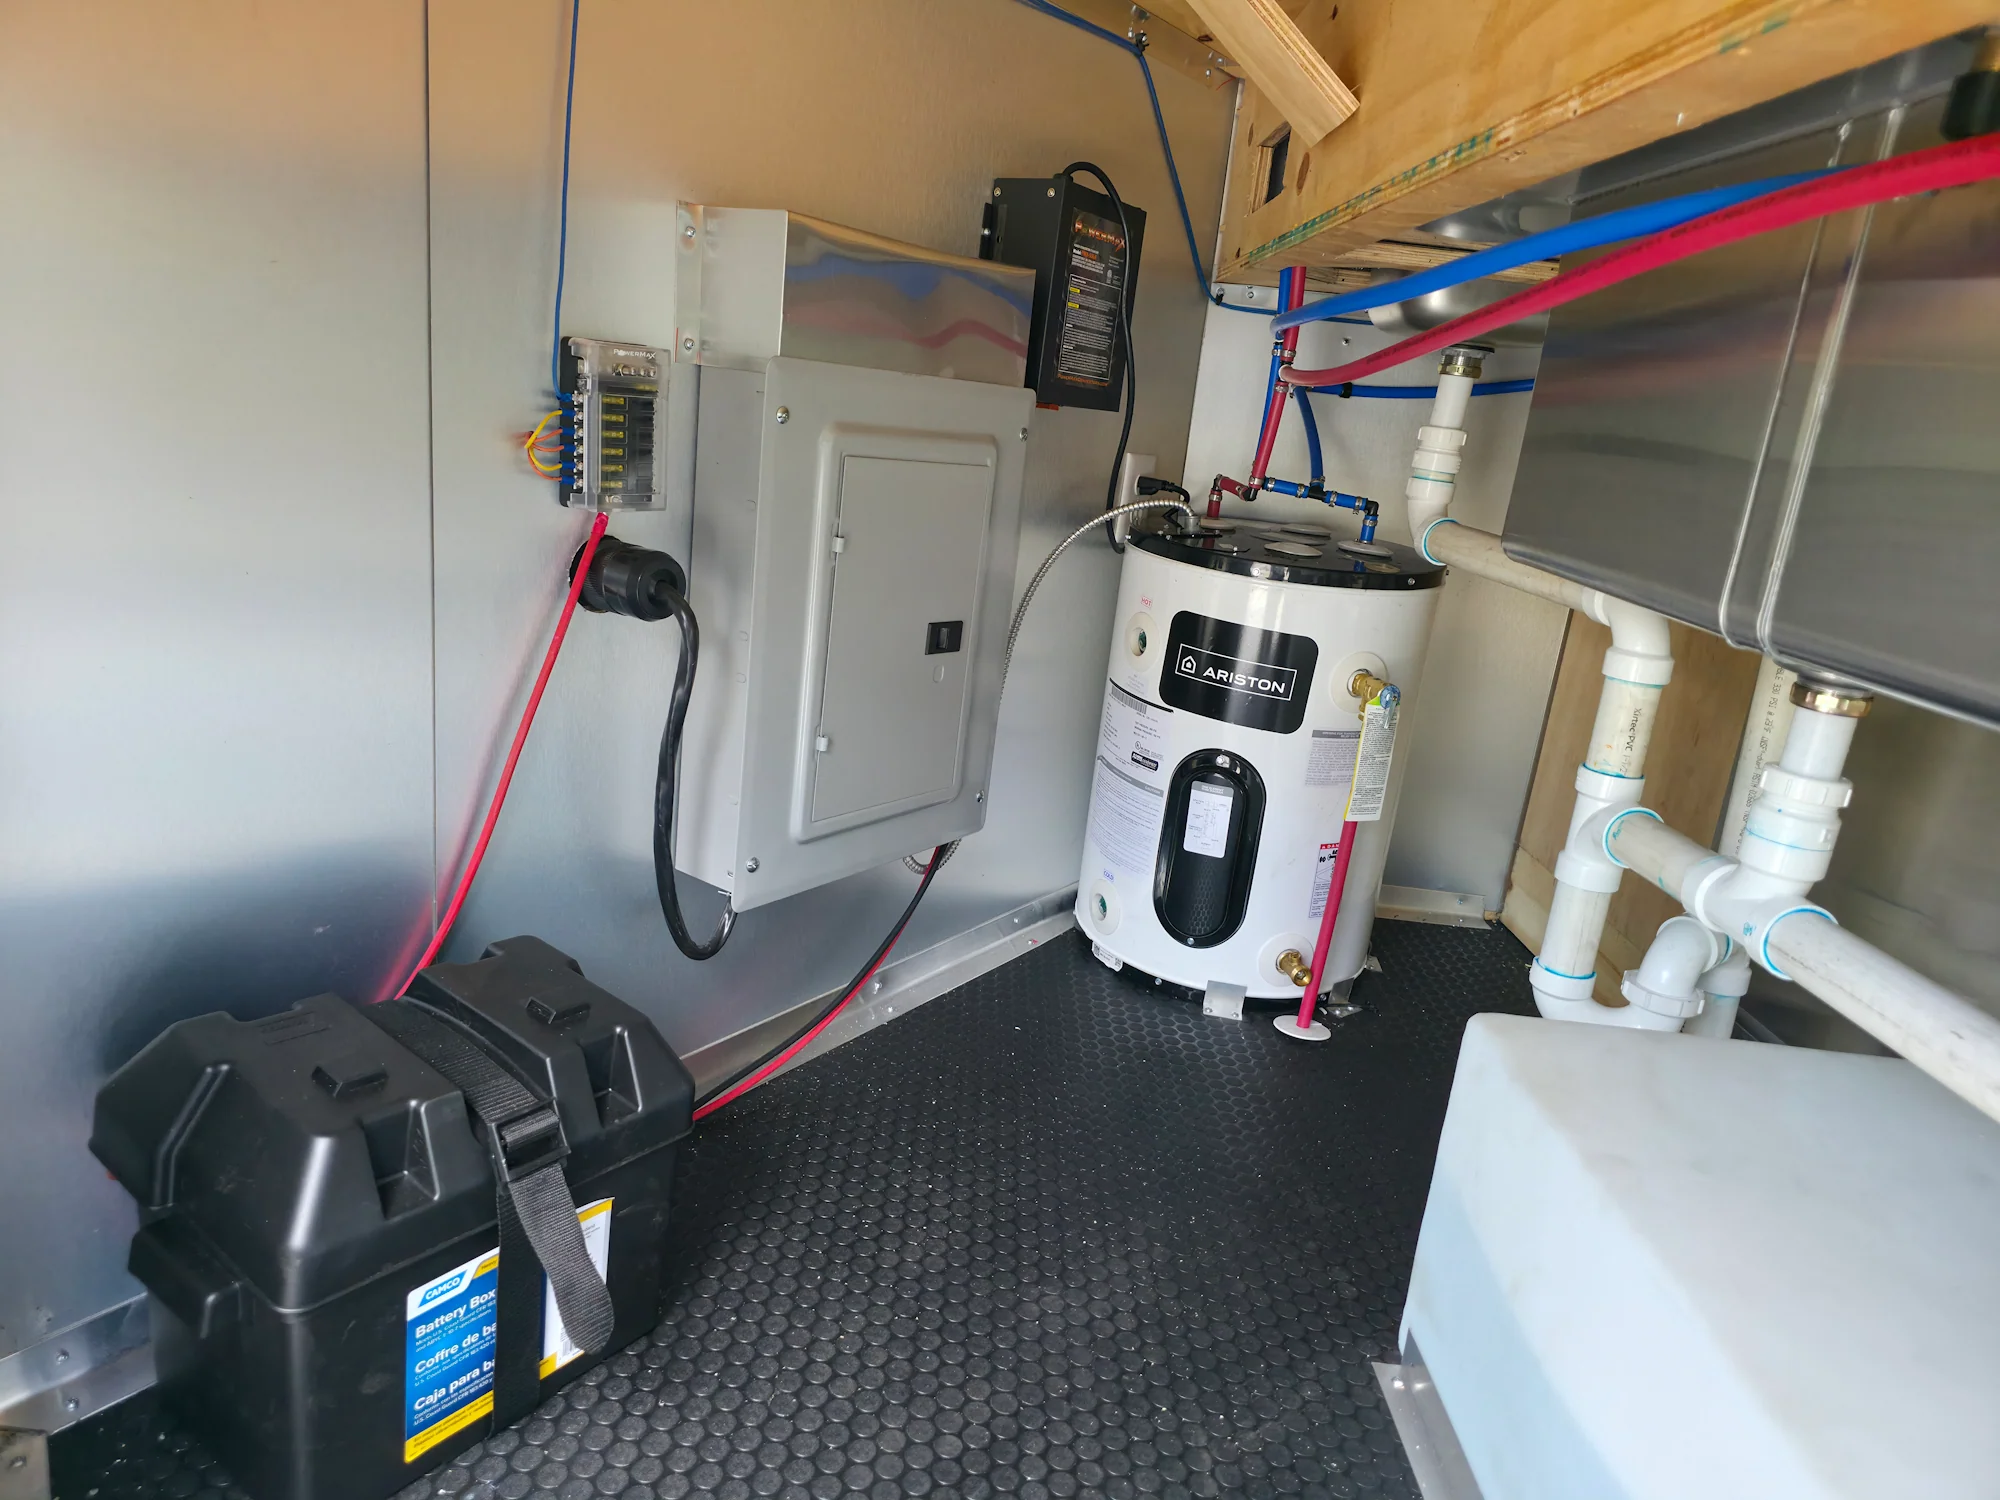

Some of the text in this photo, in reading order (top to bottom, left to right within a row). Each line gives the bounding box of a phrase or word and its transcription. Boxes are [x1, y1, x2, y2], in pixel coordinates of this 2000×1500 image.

[1141, 596, 1153, 607] HOT
[1203, 666, 1286, 694] ARISTON
[425, 1277, 461, 1300] CAMCO
[415, 1288, 496, 1339] Battery Box
[460, 1311, 475, 1322] Guard
[475, 1304, 487, 1314] CFR
[414, 1344, 459, 1374] Coffre
[462, 1332, 480, 1348] de
[426, 1369, 442, 1380] Coast
[442, 1361, 459, 1372] Guard
[459, 1353, 470, 1362] CFR
[413, 1388, 447, 1411] Caja
[449, 1367, 480, 1394] para
[425, 1407, 441, 1419] Coast
[442, 1397, 458, 1410] Guard
[458, 1391, 470, 1400] CFR
